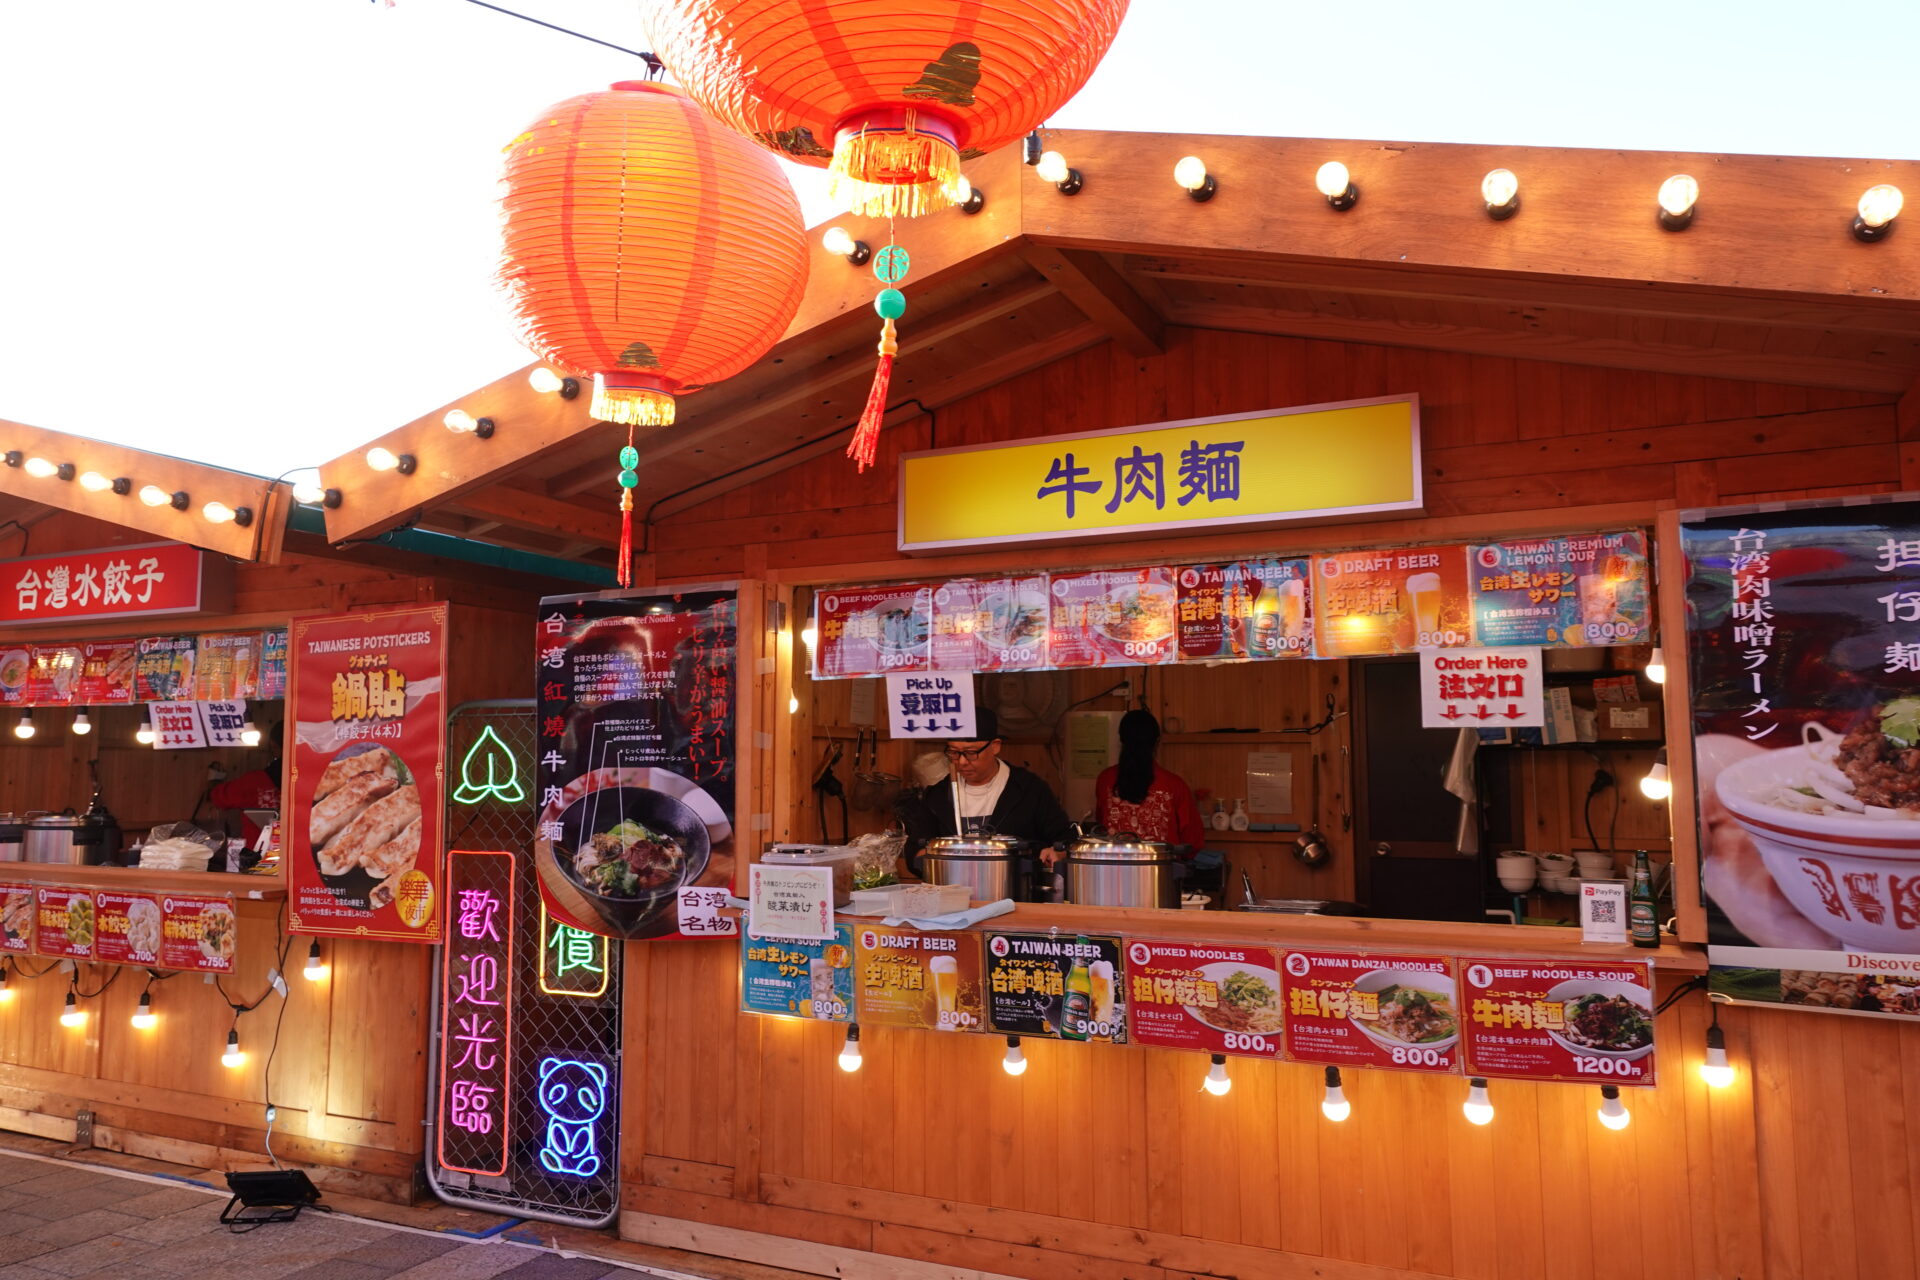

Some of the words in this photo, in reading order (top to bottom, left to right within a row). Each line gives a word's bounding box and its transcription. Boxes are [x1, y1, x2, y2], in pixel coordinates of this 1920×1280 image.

[1506, 543, 1555, 555] TAIWAN
[1559, 537, 1624, 551] PREMIUM
[1344, 558, 1393, 573] DRAFT
[1398, 554, 1440, 569] BEER
[1507, 554, 1554, 566] LEMON
[1558, 551, 1596, 562] SOUR
[1070, 578, 1098, 587] MIXED
[1101, 575, 1145, 585] NOODLES
[1203, 568, 1251, 583] TAIWAN
[1256, 566, 1292, 579] BEER
[16, 557, 165, 611] 台灣水餃子
[1006, 583, 1039, 592] NOODLES
[840, 595, 860, 604] BEEF
[862, 593, 898, 602] NOODLES
[899, 591, 922, 599] SOUP
[1529, 589, 1576, 604] サワー
[648, 613, 676, 624] Noodle
[1588, 622, 1639, 638] 800円
[1728, 527, 1780, 741] 台湾肉味噌ラーメン
[308, 638, 361, 654] TAIWANESE
[363, 631, 431, 650] POTSTICKERS
[1266, 636, 1307, 650] 900円
[1419, 631, 1465, 646] 800円
[1000, 648, 1037, 662] 800円
[1124, 641, 1164, 656] 800円
[880, 653, 919, 667] 1200円
[1435, 656, 1482, 670] Order
[1487, 655, 1528, 669] Here
[906, 678, 933, 690] Pick
[936, 678, 953, 691] Up
[1439, 673, 1524, 700] 注文口
[331, 668, 407, 723] 鍋貼
[155, 705, 174, 714] Order
[175, 705, 192, 714] Here
[209, 704, 225, 713] Pick
[225, 704, 236, 713] Up
[900, 693, 961, 715] 受取口
[680, 890, 727, 908] 台湾
[1595, 888, 1622, 897] PayPay
[405, 904, 426, 921] 夜市
[767, 900, 813, 913] 酸菜漬け
[680, 916, 732, 932] 名物
[880, 935, 919, 949] DRAFT
[923, 938, 957, 951] BEER
[1012, 940, 1061, 956] TAIWAN
[1065, 944, 1102, 958] BEER
[748, 946, 808, 965] 台湾生レモン
[1152, 947, 1187, 957] MIXED
[1190, 949, 1245, 961] NOODLES
[778, 964, 808, 977] サワー
[1310, 957, 1349, 968] TAIWAN
[1351, 959, 1391, 970] DANZAI
[1392, 961, 1444, 973] NOODLES
[865, 963, 924, 990] 生啤酒
[1495, 968, 1528, 978] BEEF
[1532, 969, 1595, 981] NOODLES
[1599, 971, 1636, 982] SOUP
[451, 889, 502, 1135] 歡迎光臨
[814, 1000, 848, 1015] 800円
[940, 1011, 977, 1025] 800円
[1076, 1020, 1118, 1035] 900円
[1224, 1032, 1275, 1052] 800円
[1392, 1047, 1449, 1066] 800円
[1573, 1056, 1641, 1076] 1200円
